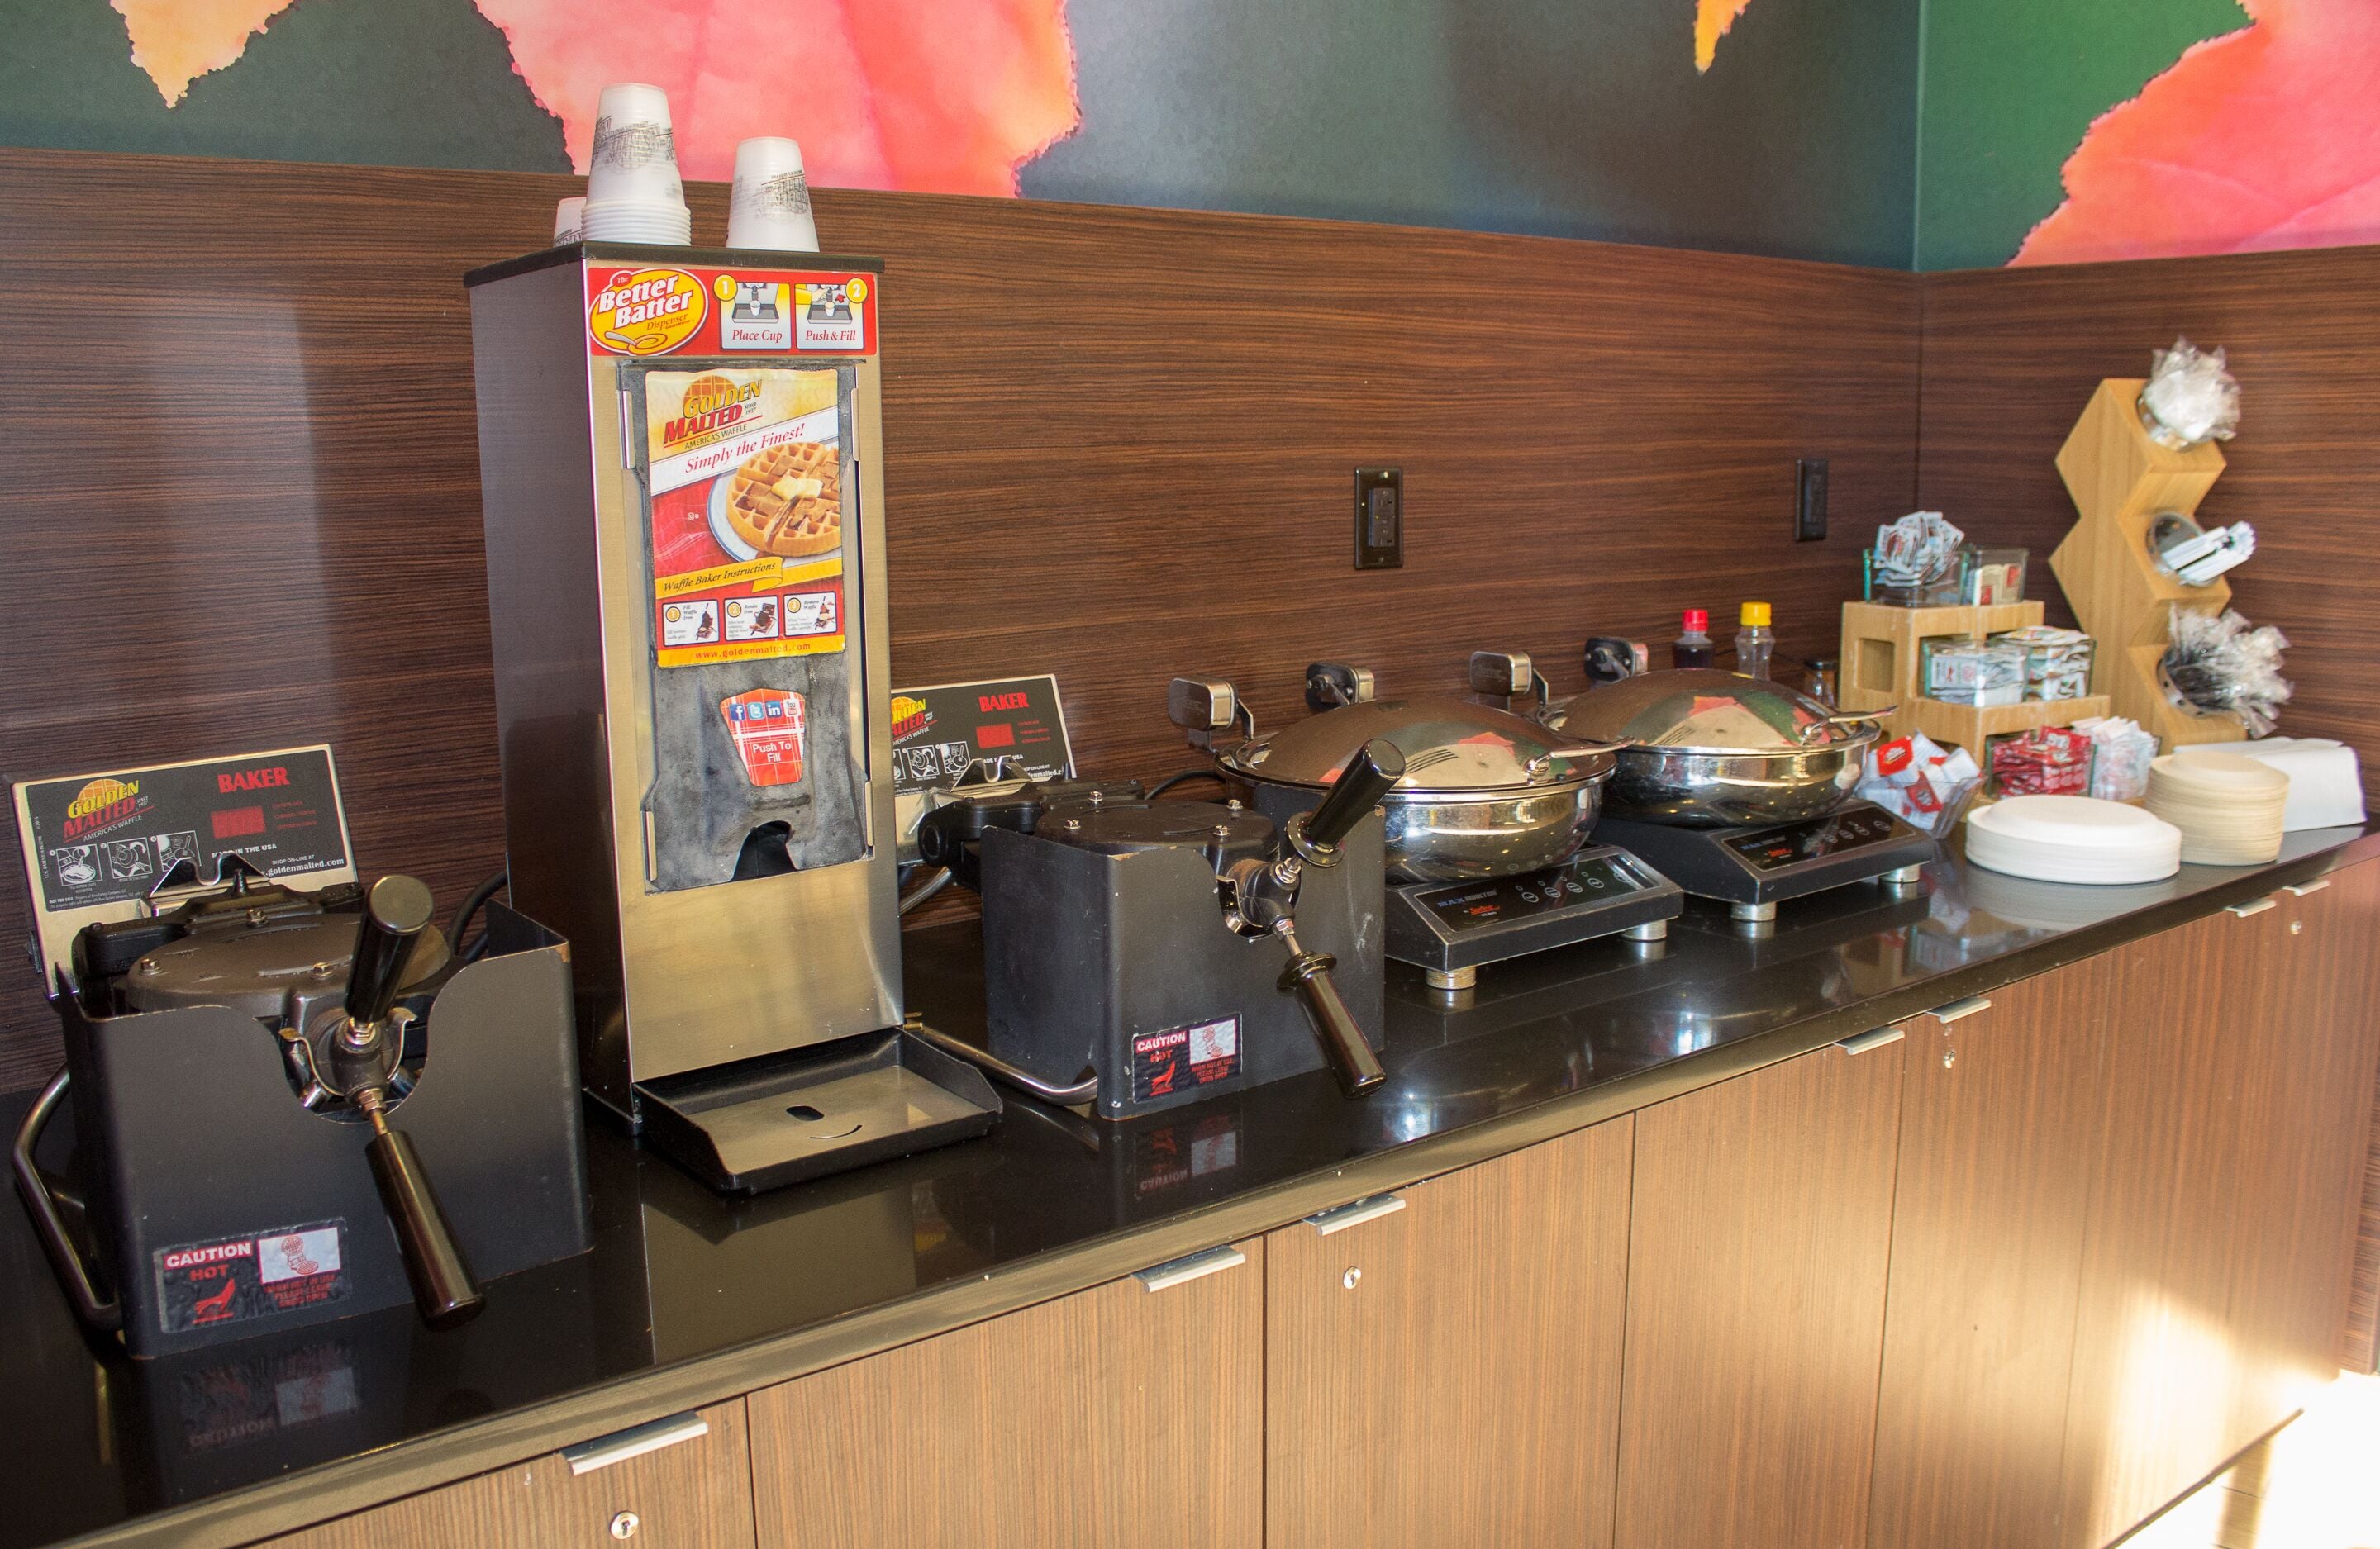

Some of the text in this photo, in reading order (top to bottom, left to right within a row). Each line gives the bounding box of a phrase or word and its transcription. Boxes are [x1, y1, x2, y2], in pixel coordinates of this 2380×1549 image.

[616, 275, 629, 283] The
[722, 282, 728, 294] 1
[597, 274, 678, 313] Better
[854, 284, 861, 297] 2
[614, 290, 693, 330] Batter
[646, 313, 688, 331] Dispenser
[732, 330, 783, 344] Place Cup
[805, 330, 856, 341] Push & Fill
[683, 379, 763, 418] GOLDEN
[744, 402, 757, 411] SINCE
[663, 404, 743, 444] MALTED
[684, 424, 747, 449] AMERICA'S WAFFLE
[685, 423, 805, 473] Simply the Finest!
[664, 562, 776, 592] Waffle Baker Instructions
[695, 643, 811, 659] www.goldenmalted.com
[768, 704, 780, 715] in
[978, 692, 1029, 713] BAKER
[913, 727, 929, 739] WAFFLE
[753, 742, 792, 753] Push To
[767, 753, 781, 762] Fill
[217, 767, 290, 794] BAKER
[68, 780, 139, 819] GOLDEN
[64, 796, 136, 838] MALTED
[83, 815, 142, 842] AMERICA'S WAFFLE
[261, 858, 345, 877] .goldenmalted.com
[1137, 1033, 1187, 1052] CAUTION
[1150, 1049, 1173, 1062] HOT
[1196, 1069, 1215, 1077] PLEASE
[166, 1243, 251, 1268] CAUTION
[189, 1265, 230, 1281] HOT
